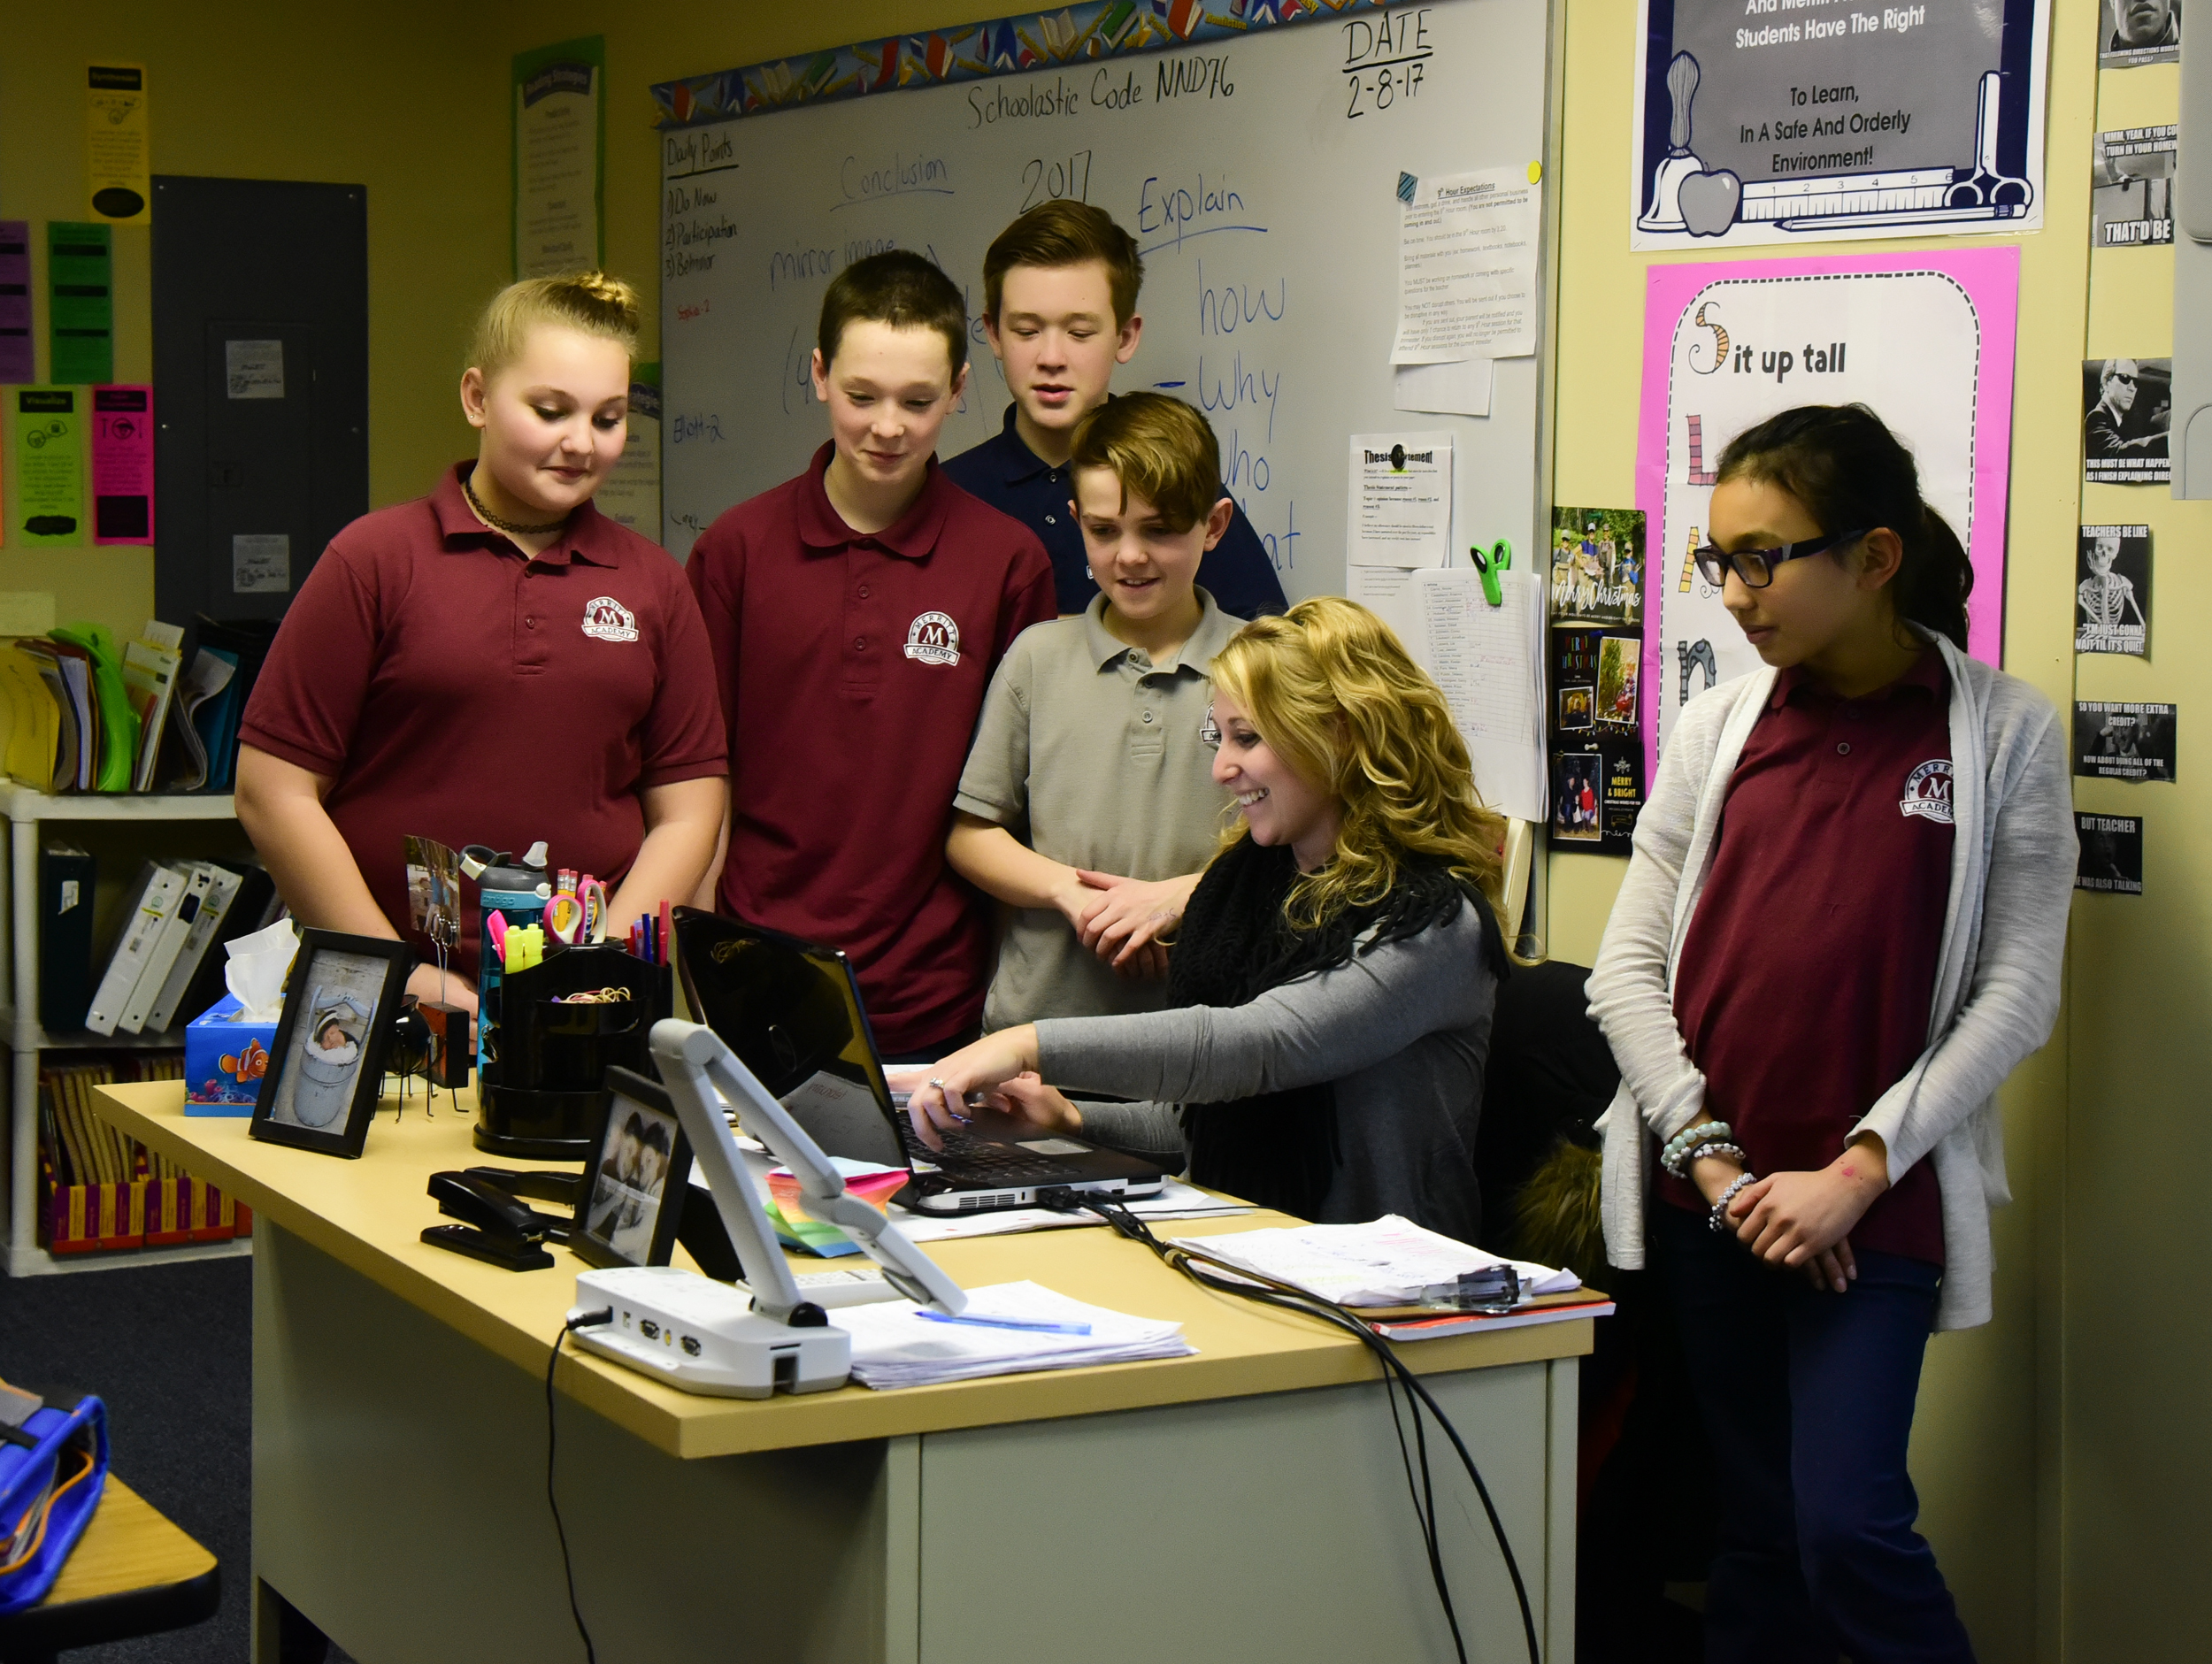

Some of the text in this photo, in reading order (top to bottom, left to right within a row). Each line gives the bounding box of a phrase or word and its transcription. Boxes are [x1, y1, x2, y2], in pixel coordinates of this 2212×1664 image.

[1342, 10, 1432, 64] DATE
[1735, 5, 1925, 49] Students Have The Right
[2138, 55, 2154, 64] PASS?
[968, 55, 1235, 129] Schoolastic Code NND76
[1348, 63, 1424, 119] 2-8-17
[1790, 82, 1859, 106] To Learn,
[1740, 109, 1912, 143] In A Safe And Orderly
[2144, 128, 2152, 140] IF
[2152, 127, 2166, 139] YOU
[2166, 125, 2177, 138] CO
[667, 134, 697, 172] Daily
[1771, 145, 1874, 173] Environment!
[2105, 145, 2124, 157] TURN
[2124, 144, 2133, 157] IN
[2133, 142, 2152, 156] YOUR
[841, 152, 948, 199] Conclusion
[1020, 150, 1092, 214] 2017
[1770, 186, 1777, 195] 1
[1802, 182, 1810, 192] 2
[1837, 180, 1845, 189] 3
[1871, 178, 1879, 187] 4
[1910, 174, 1918, 184] 5
[1138, 173, 1245, 254] Explain
[2104, 219, 2171, 244] THAT'D BE
[770, 242, 835, 291] mirror
[1198, 257, 1285, 336] how
[1761, 349, 1793, 384] up
[1803, 342, 1847, 373] tall
[1199, 349, 1280, 444] Why
[1363, 449, 1432, 464] Thesis tement
[2085, 457, 2171, 469] THIS MUST BE WHAT HAPPEN
[2117, 471, 2153, 480] EXPLAINING
[2153, 471, 2171, 480] DIRE
[2082, 525, 2147, 538] TEACHERS BE LIKE
[1551, 579, 1641, 610] Merry Christmas
[598, 608, 621, 626] M
[915, 615, 955, 635] MERRITT
[591, 627, 631, 638] ACADEMY
[921, 625, 945, 646] M
[912, 648, 952, 659] ACADEMY
[2078, 702, 2169, 715] SO YOU WANT MORE EXTRA
[2108, 717, 2136, 726] CREDIT?
[2097, 755, 2116, 764] ABOUT
[2132, 757, 2144, 766] ALL
[2153, 758, 2164, 767] THE
[1611, 776, 1632, 786] MERRY
[2122, 767, 2148, 777] CREDIT?
[1613, 787, 1637, 798] BRIGHT
[1924, 777, 1952, 802] M
[2080, 816, 2136, 833] BUT TEACHER
[2095, 878, 2113, 889] ALSO
[2113, 879, 2142, 892] TALKING
